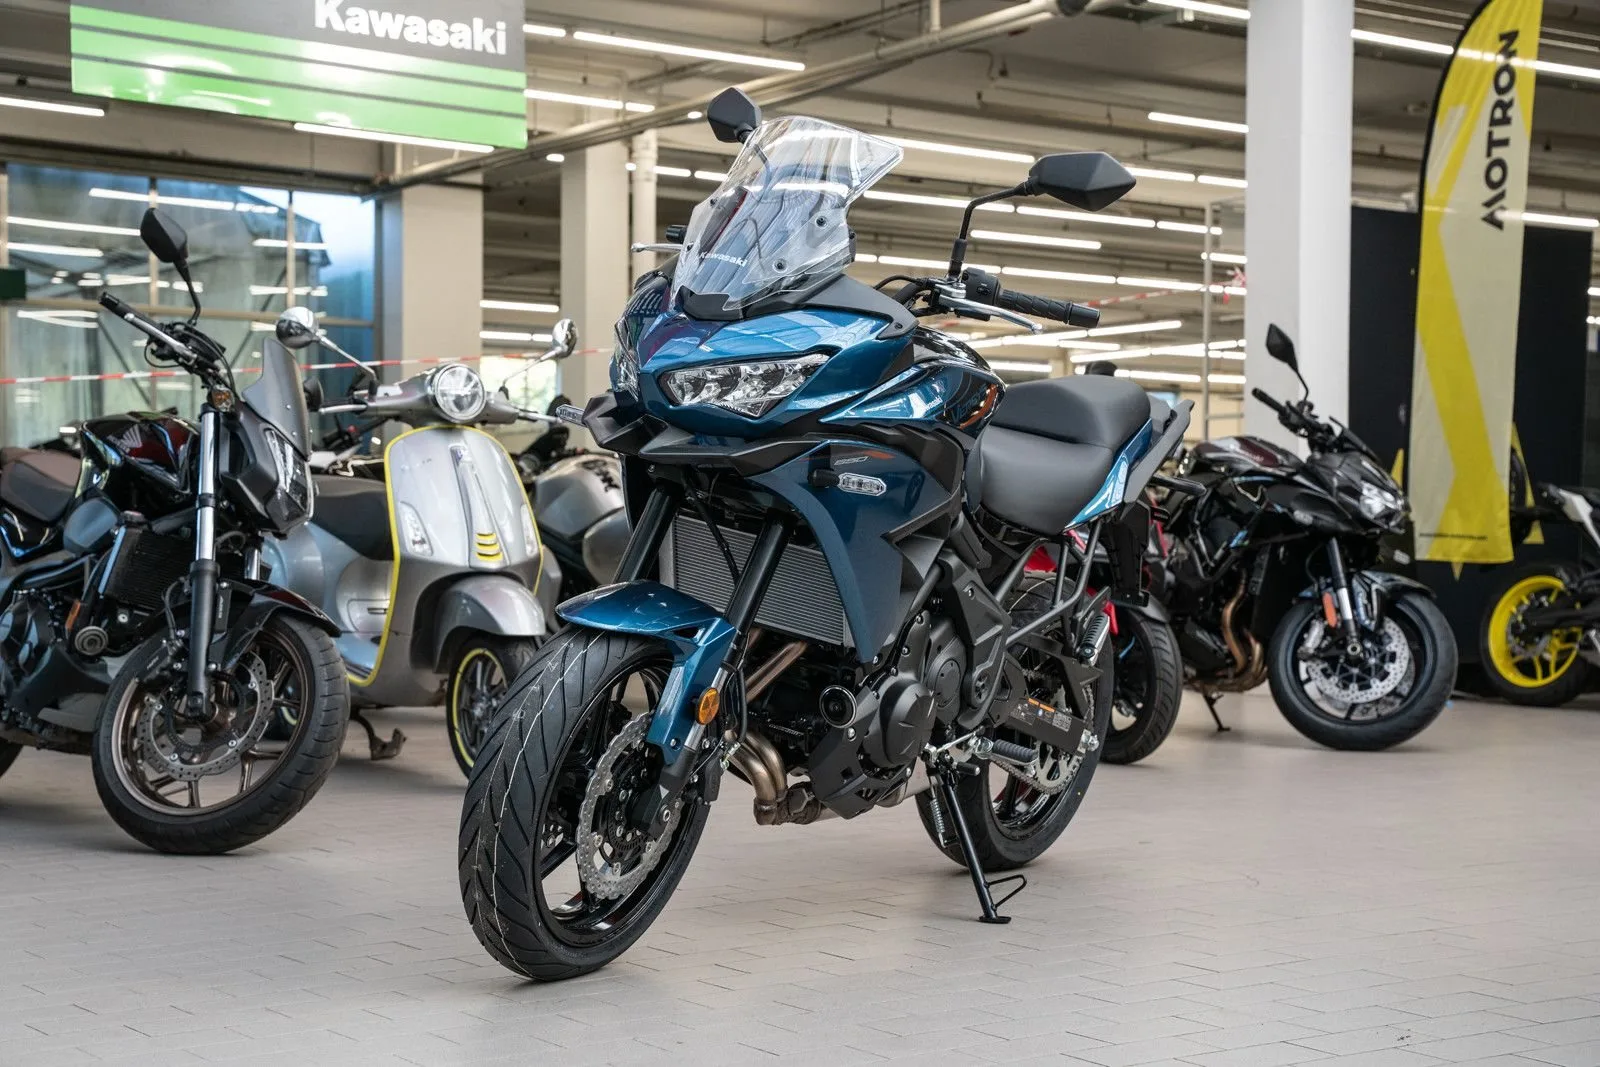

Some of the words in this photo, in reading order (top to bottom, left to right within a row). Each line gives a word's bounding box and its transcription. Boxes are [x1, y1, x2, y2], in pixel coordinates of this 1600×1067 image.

[314, 0, 507, 55] Kawasaki
[1480, 28, 1519, 231] MOTRON
[700, 251, 748, 268] Kawasaki
